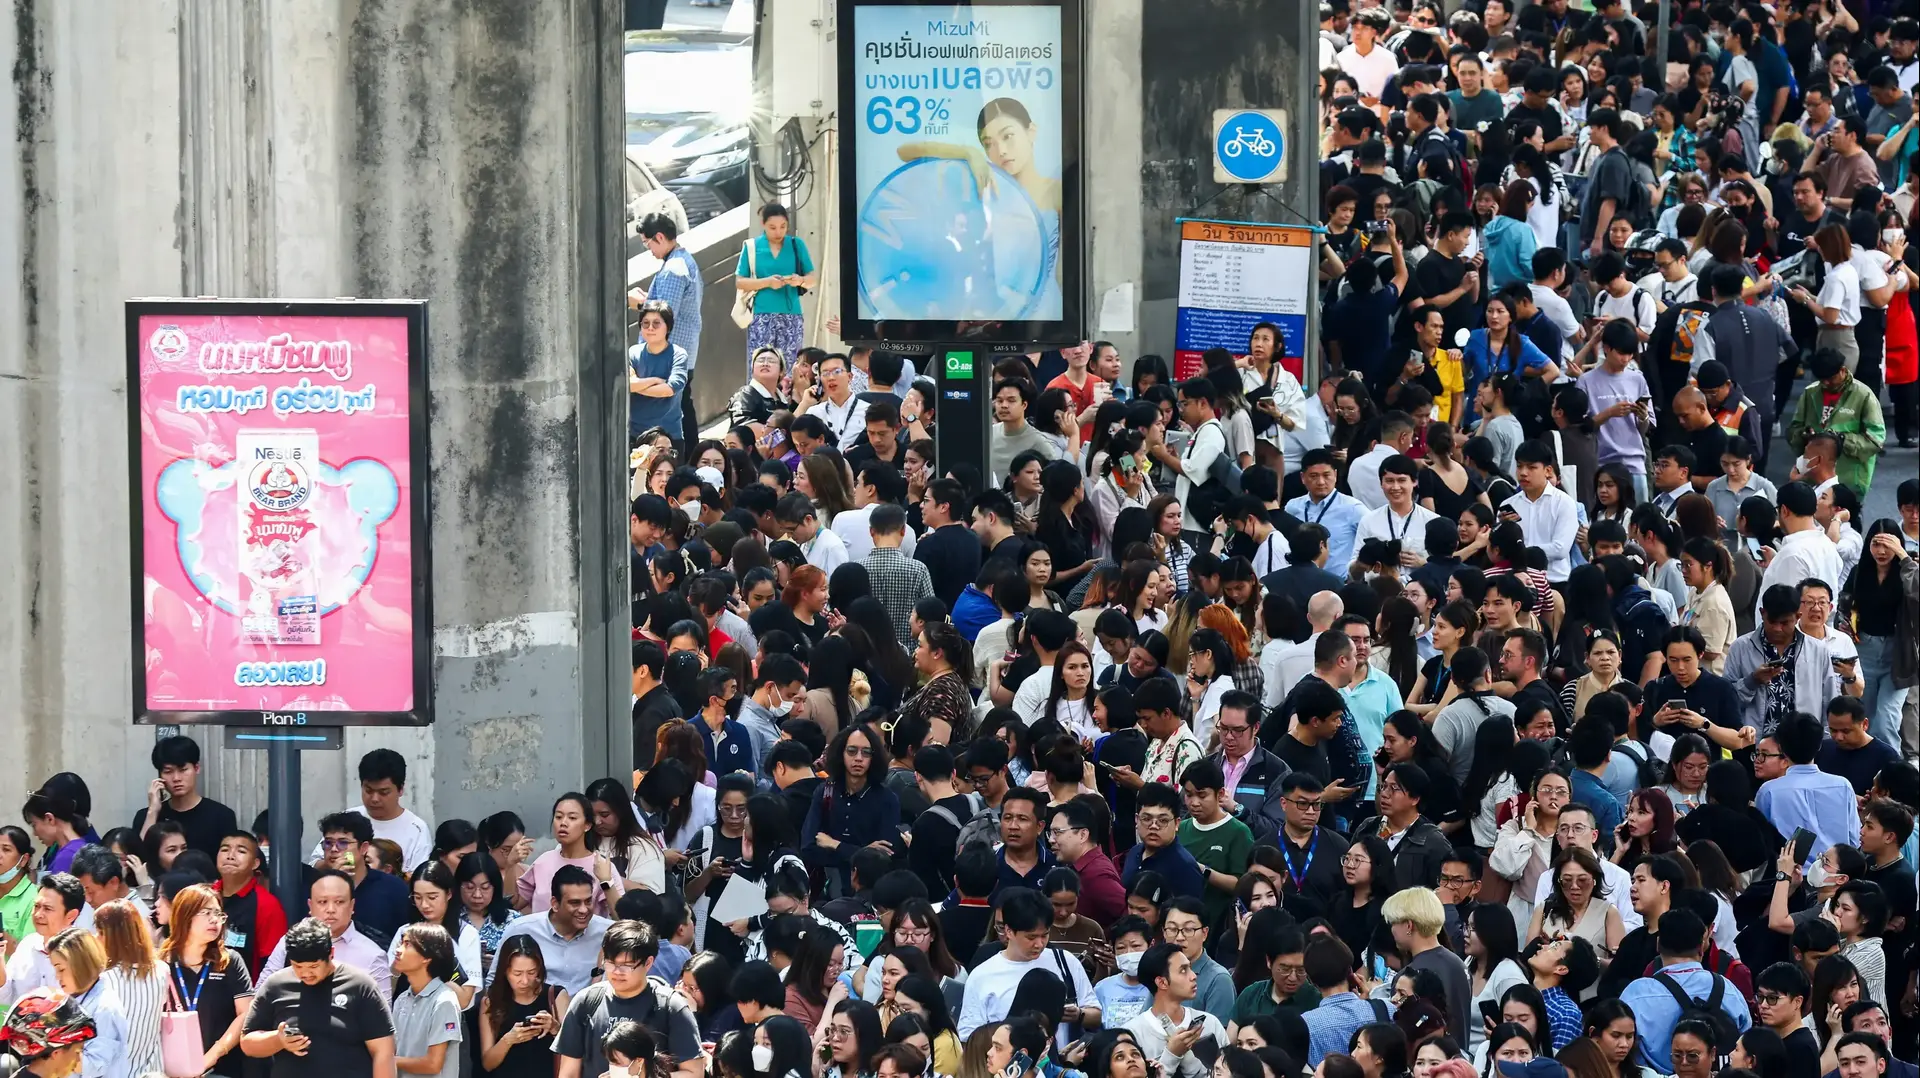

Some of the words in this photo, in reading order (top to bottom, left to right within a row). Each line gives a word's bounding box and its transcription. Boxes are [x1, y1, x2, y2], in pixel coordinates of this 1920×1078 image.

[928, 20, 990, 36] MizuMi
[252, 487, 275, 507] BEAR
[278, 486, 307, 508] BRAND
